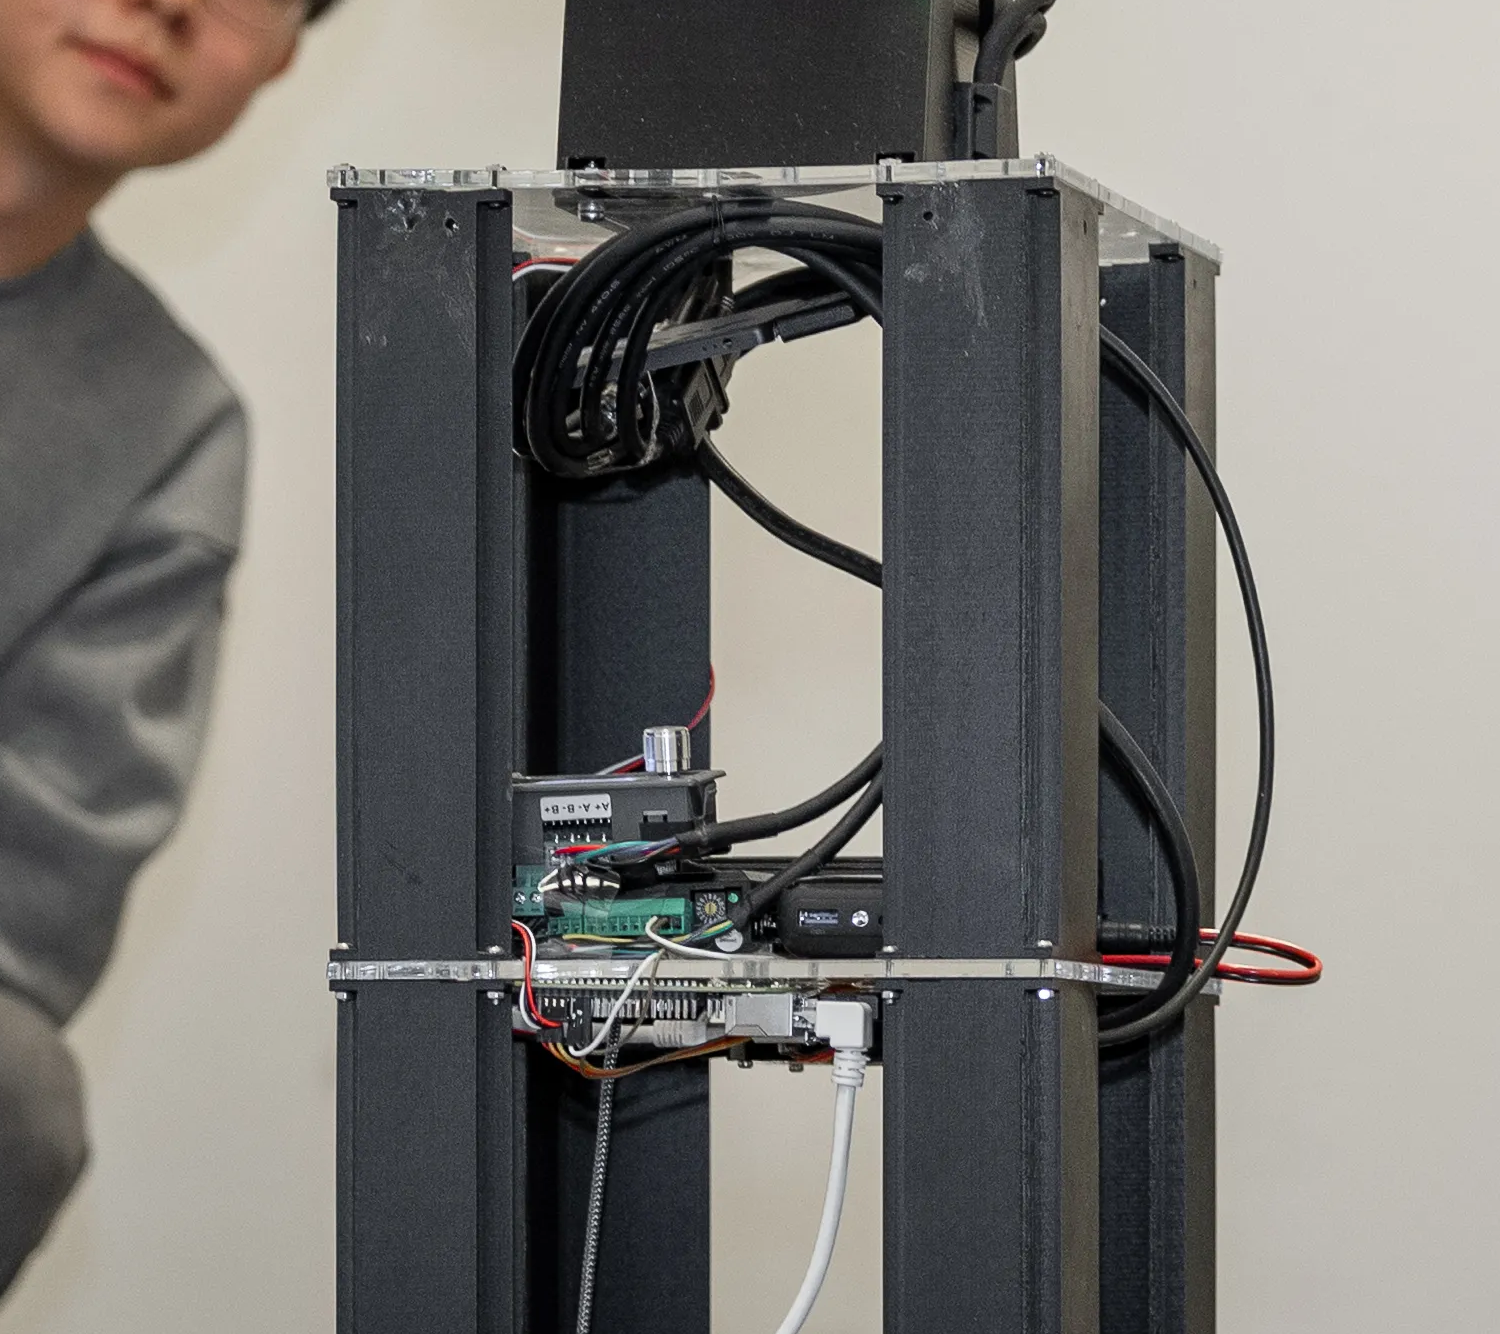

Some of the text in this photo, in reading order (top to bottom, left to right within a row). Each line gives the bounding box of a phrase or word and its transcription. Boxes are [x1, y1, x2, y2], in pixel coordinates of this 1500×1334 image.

[544, 802, 610, 815] A+ A- B- B+
